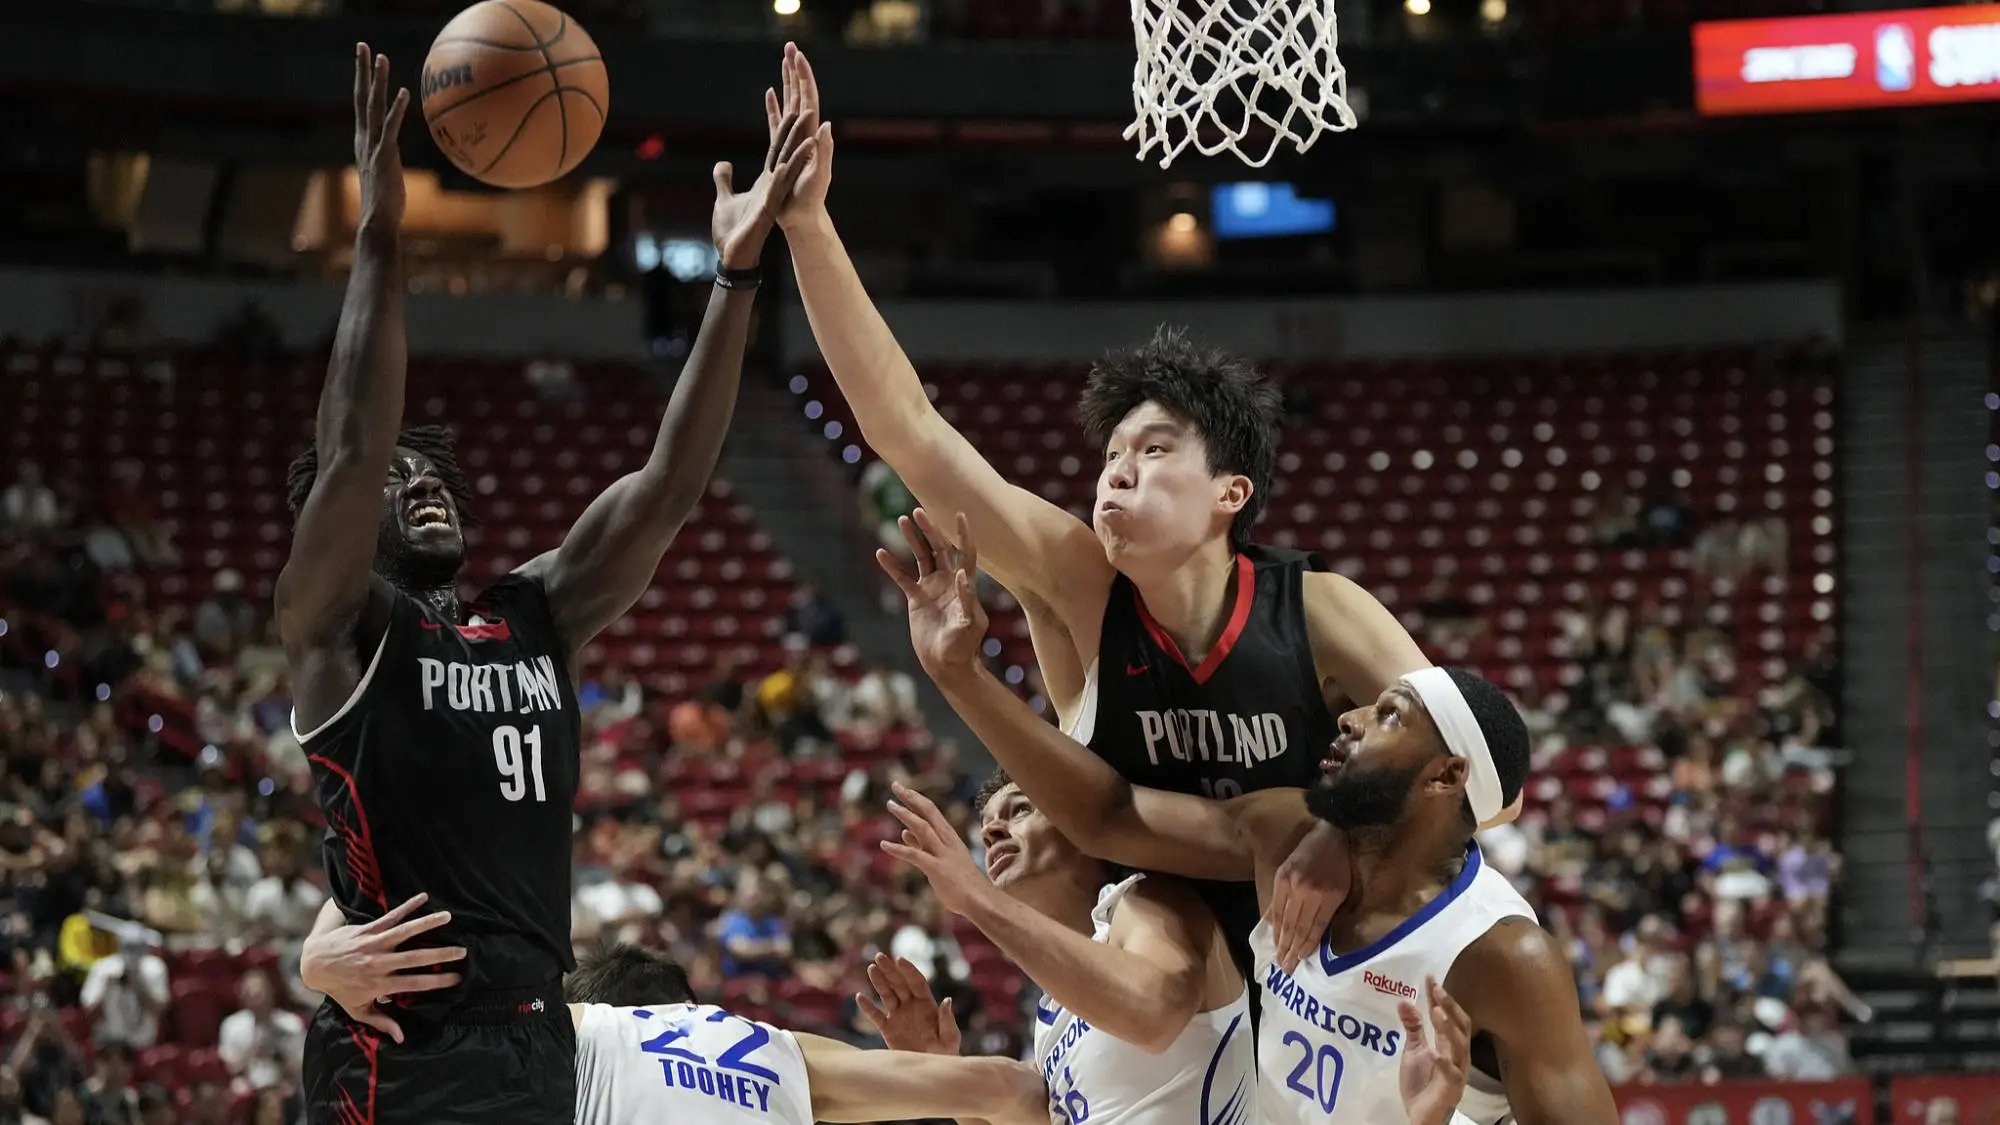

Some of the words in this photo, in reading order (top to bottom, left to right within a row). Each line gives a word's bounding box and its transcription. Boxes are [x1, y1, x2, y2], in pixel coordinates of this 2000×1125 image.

[492, 724, 546, 802] 91
[1266, 963, 1400, 1057] WARRIORS
[1363, 970, 1417, 999] Rakuten
[658, 1058, 771, 1113] TOOHEY
[1282, 1030, 1344, 1115] 20
